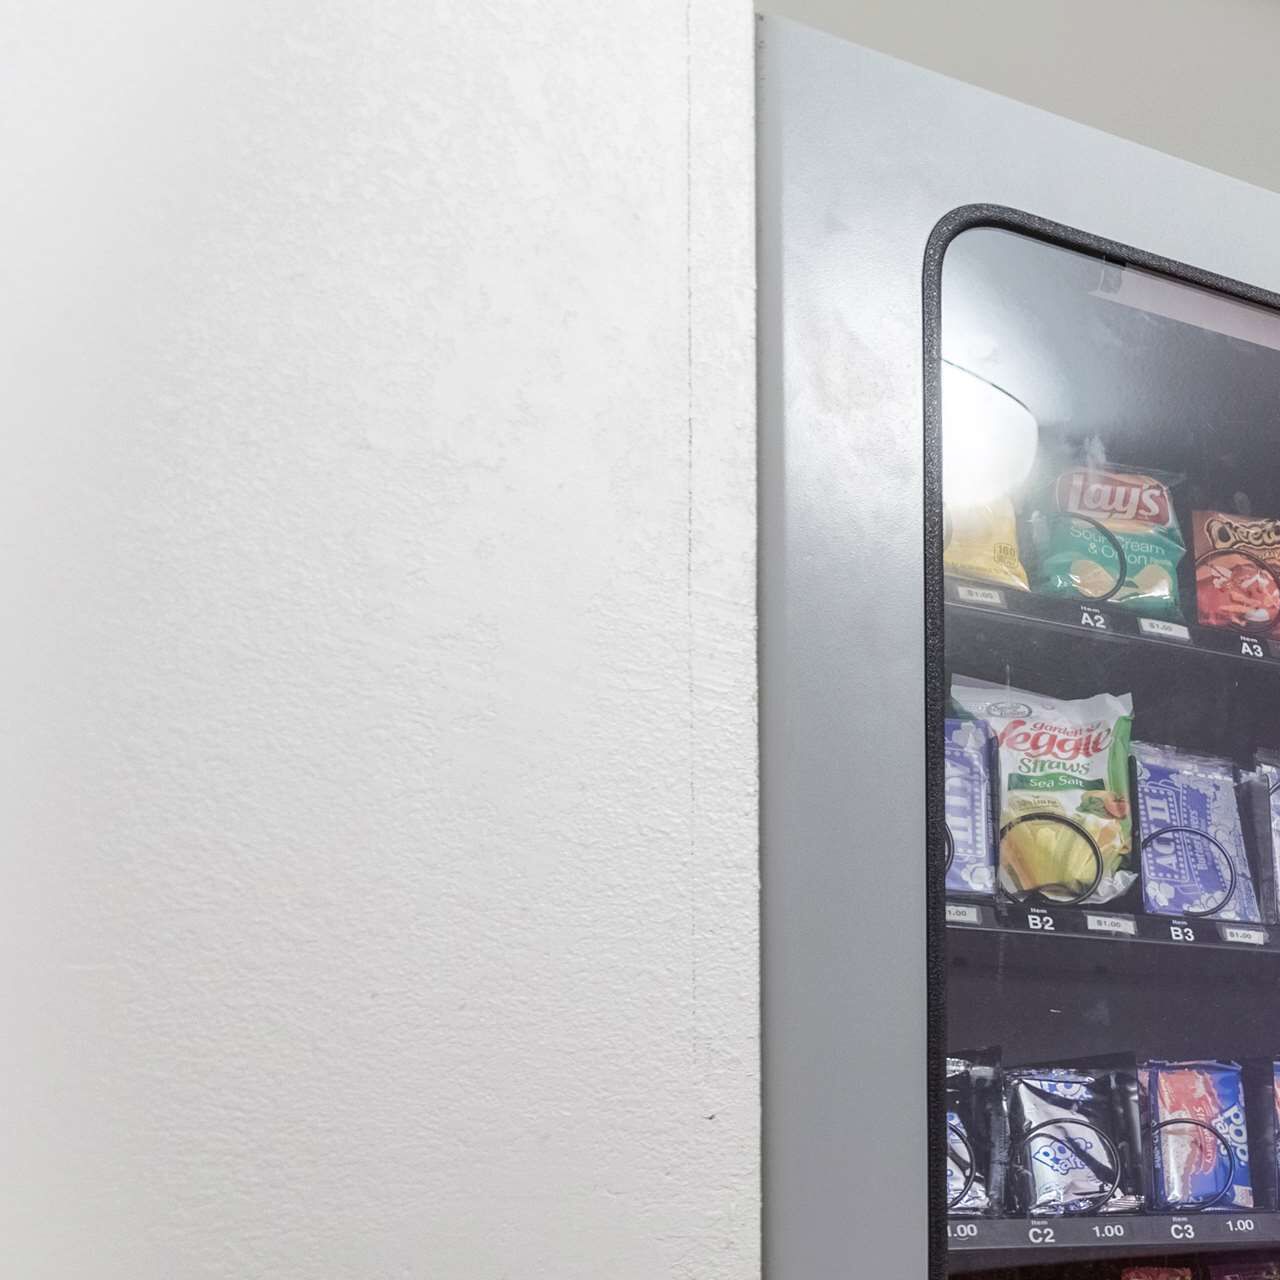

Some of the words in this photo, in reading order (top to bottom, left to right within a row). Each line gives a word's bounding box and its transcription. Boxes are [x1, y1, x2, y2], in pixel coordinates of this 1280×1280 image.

[1066, 473, 1162, 522] Lay's
[1081, 613, 1106, 629] A2
[1241, 642, 1264, 658] A3
[1030, 720, 1083, 738] garden
[999, 720, 1112, 760] Veggie
[1018, 757, 1092, 774] Straws
[1029, 776, 1055, 788] Sea
[1058, 775, 1085, 788] Salt
[1028, 914, 1055, 931] B2
[1170, 926, 1195, 941] B3
[1093, 1224, 1125, 1238] 1.00
[1171, 1224, 1195, 1239] C3
[1226, 1219, 1254, 1232] 1.00
[1028, 1228, 1056, 1243] C2
